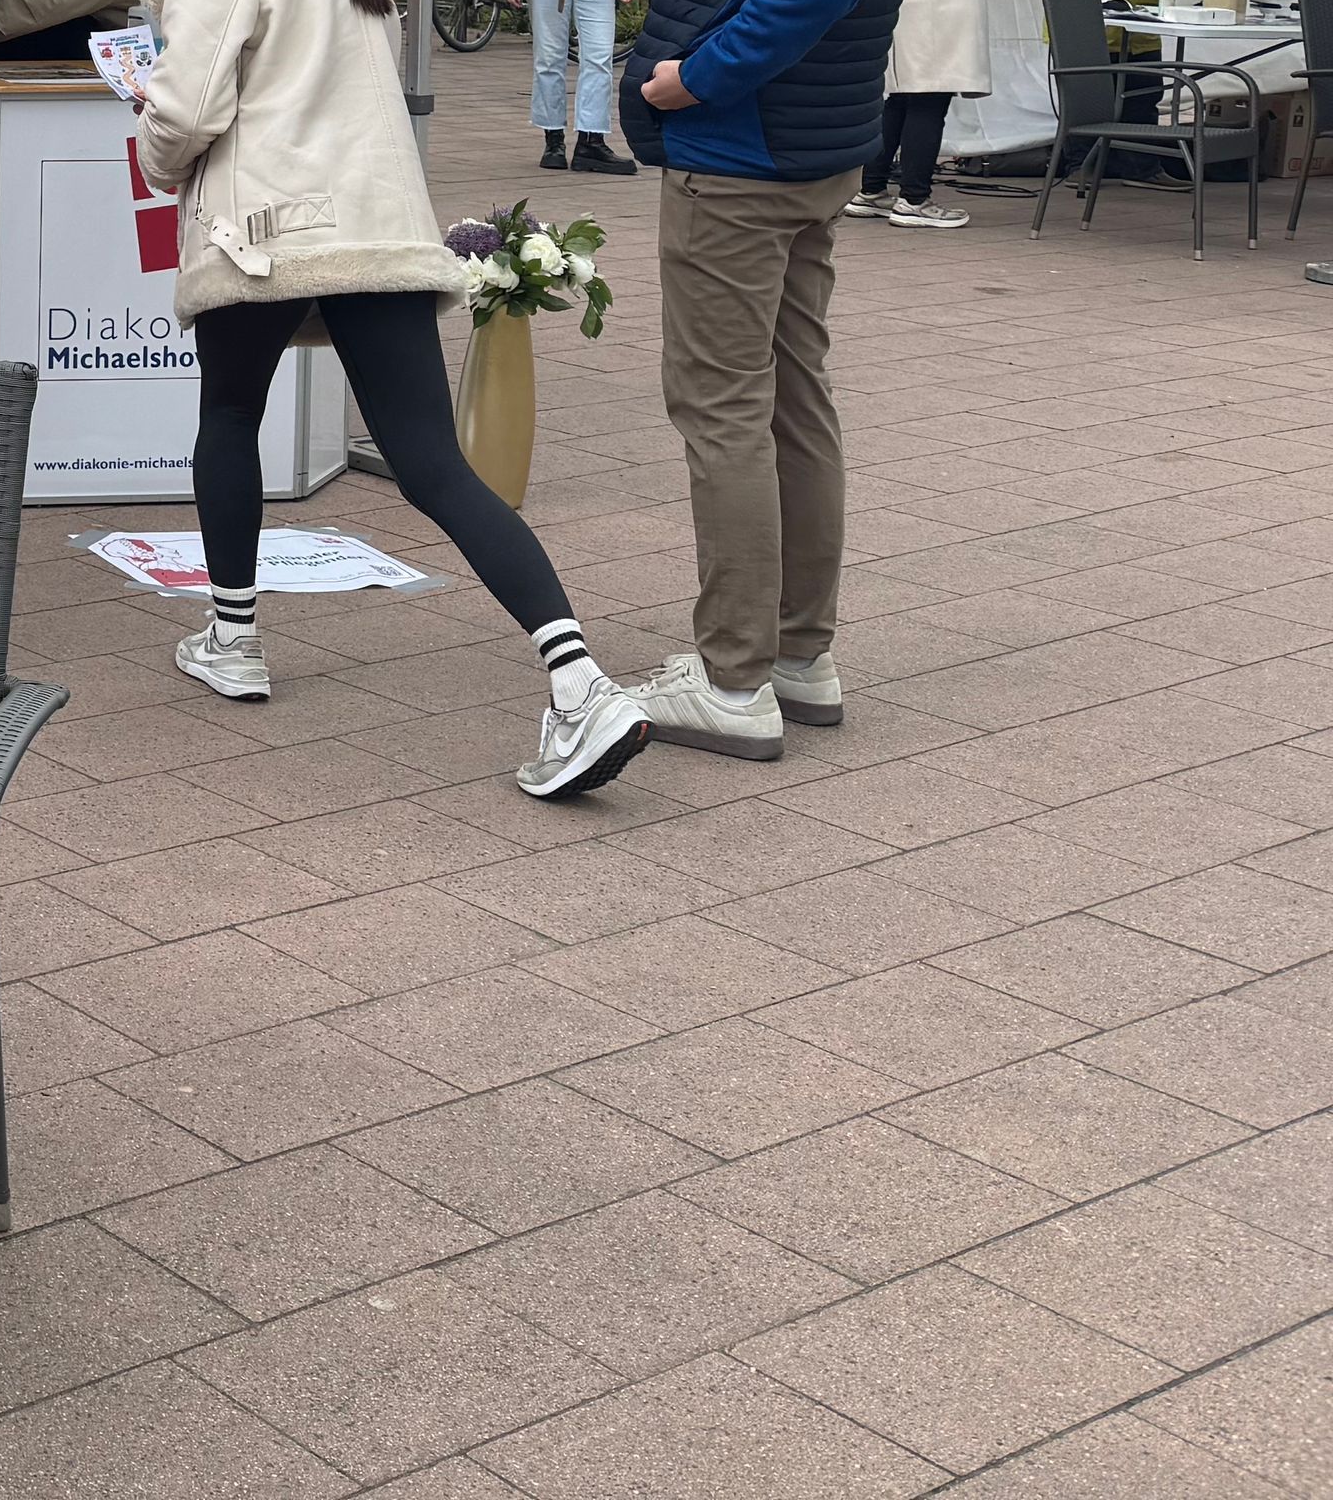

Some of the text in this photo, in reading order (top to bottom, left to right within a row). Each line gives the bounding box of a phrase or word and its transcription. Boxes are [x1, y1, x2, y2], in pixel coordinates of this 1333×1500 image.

[48, 307, 184, 341] Diako
[48, 345, 197, 370] Michaelsho
[33, 456, 194, 470] www.diakonie-michaels
[256, 550, 340, 562] nationaler
[268, 555, 370, 567] Pflegenden
